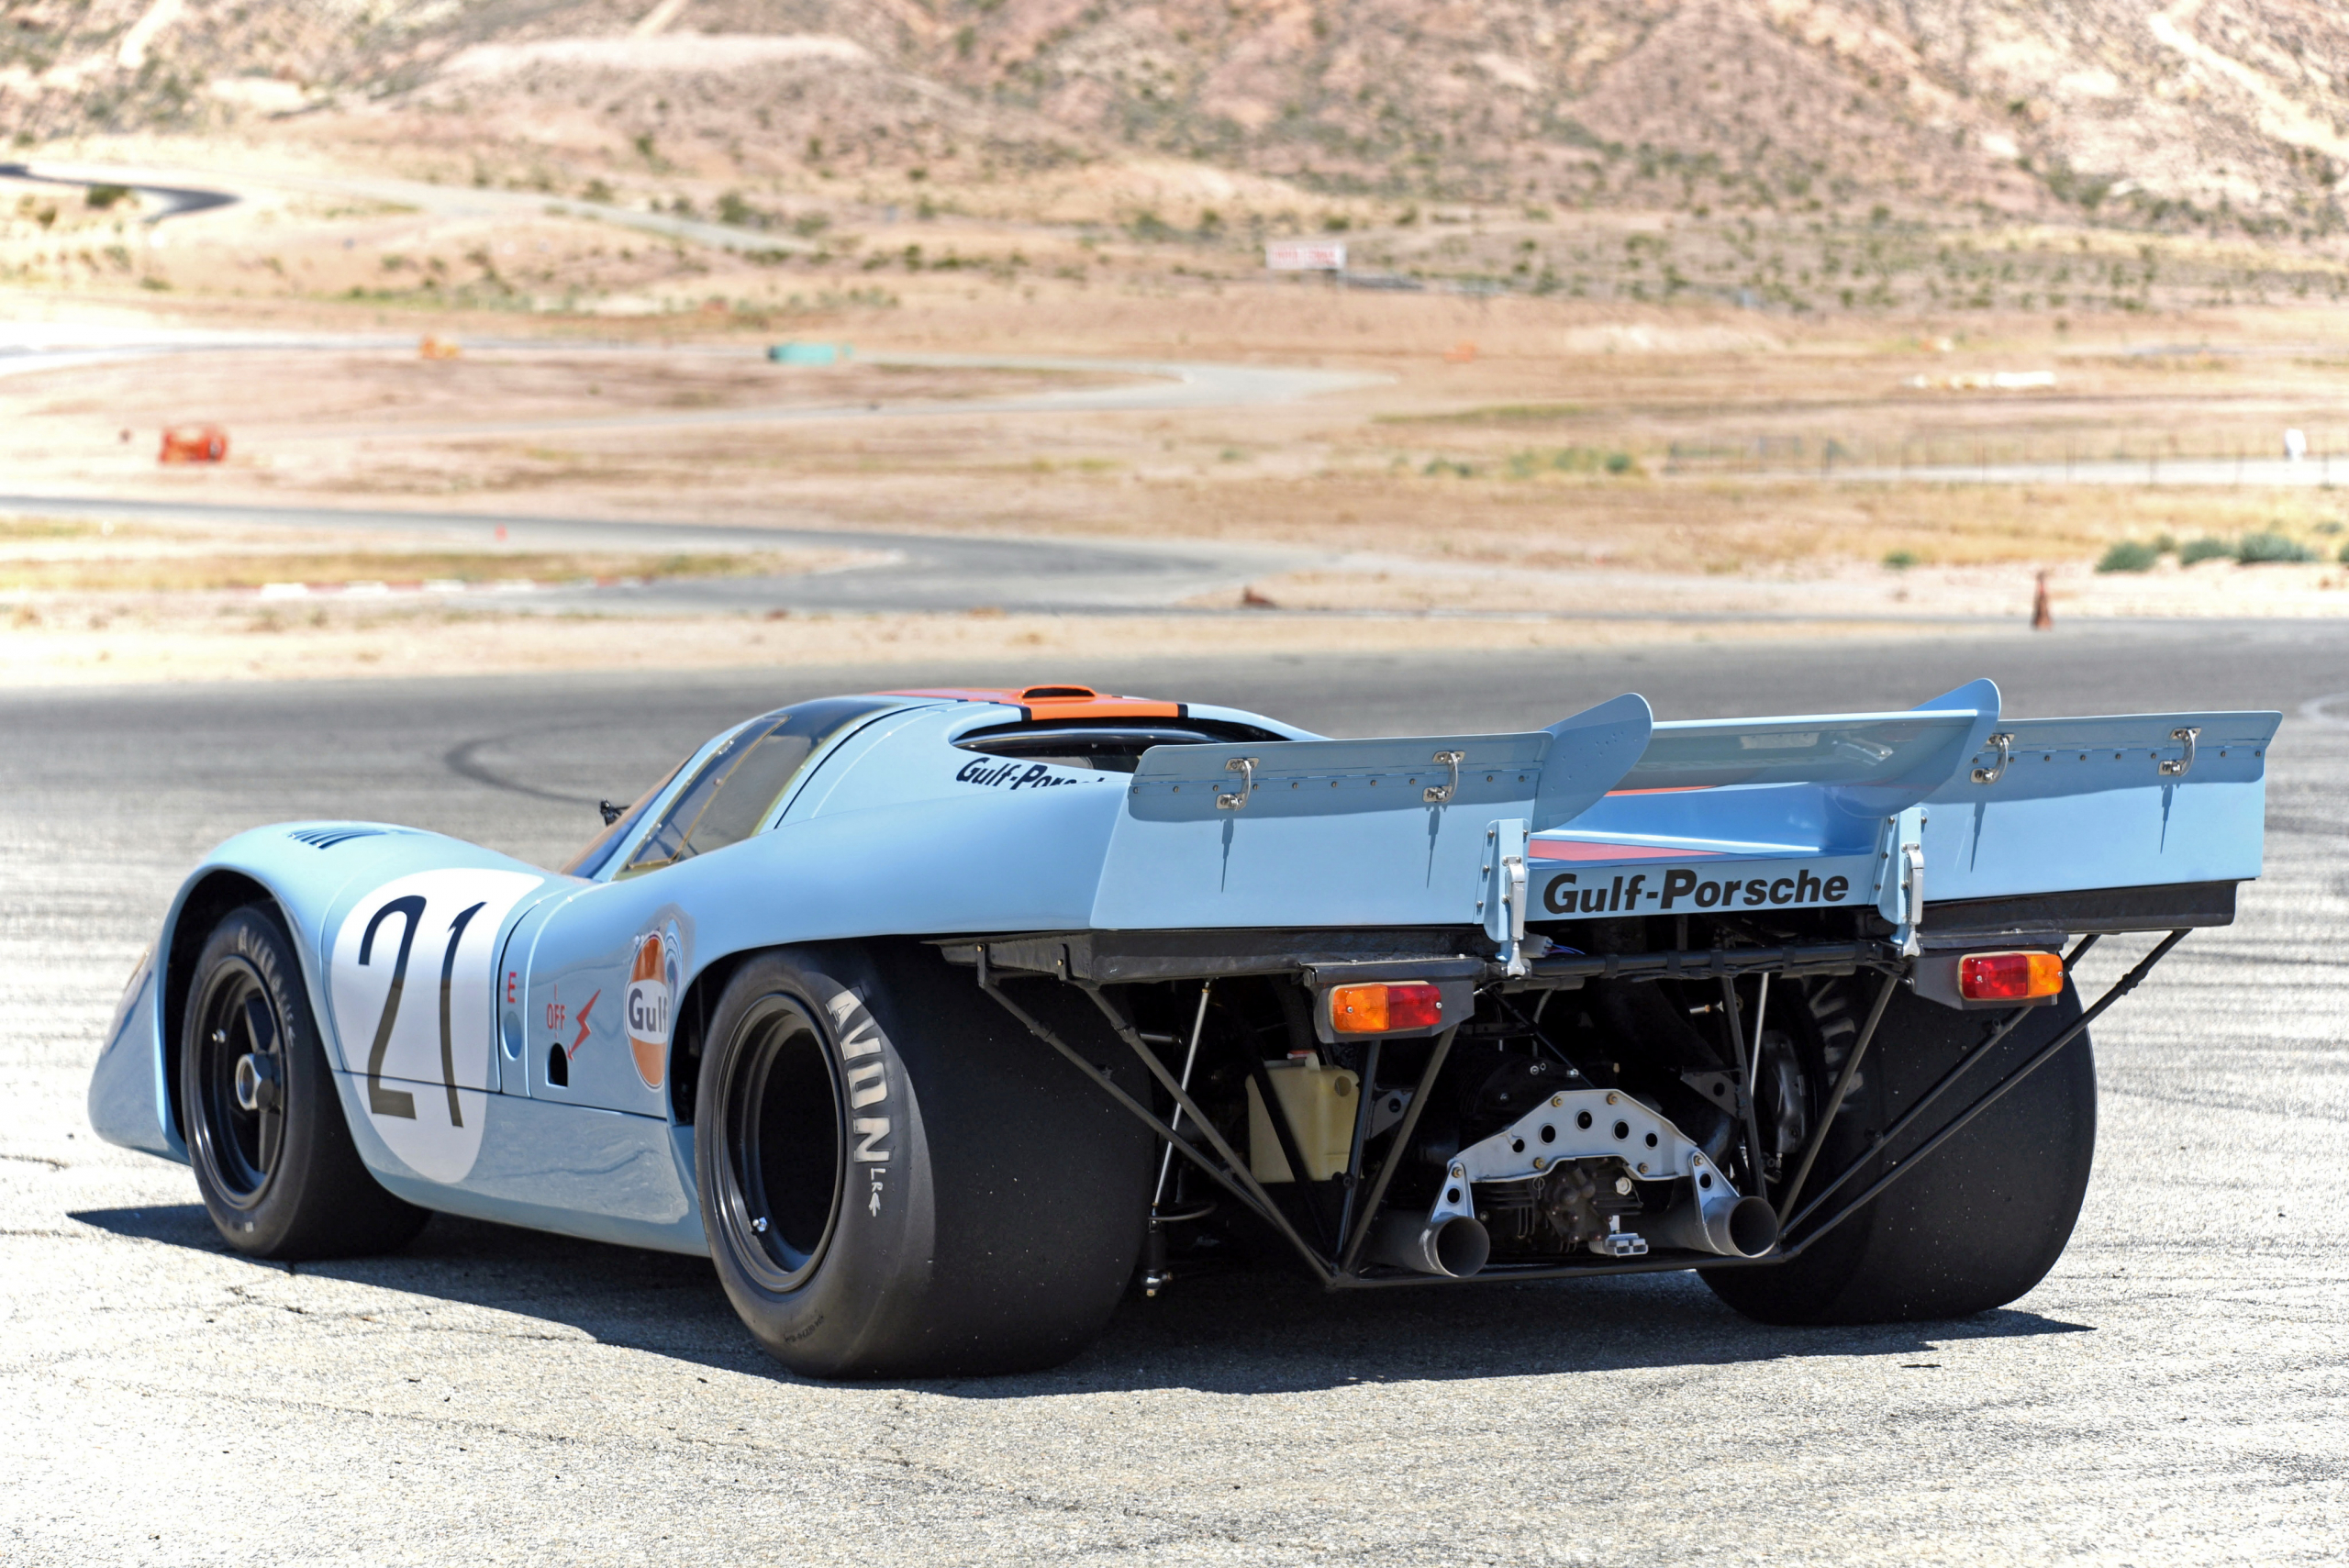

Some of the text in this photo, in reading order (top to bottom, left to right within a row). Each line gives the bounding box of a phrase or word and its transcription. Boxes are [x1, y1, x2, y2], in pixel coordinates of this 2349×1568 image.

[1542, 869, 1849, 915] Gulf-Porsche
[507, 972, 517, 1004] E
[629, 987, 668, 1034] Gulf
[358, 895, 488, 1128] 21
[546, 1003, 566, 1030] OFF
[826, 985, 891, 1162] AVON
[870, 1167, 886, 1193] LR
